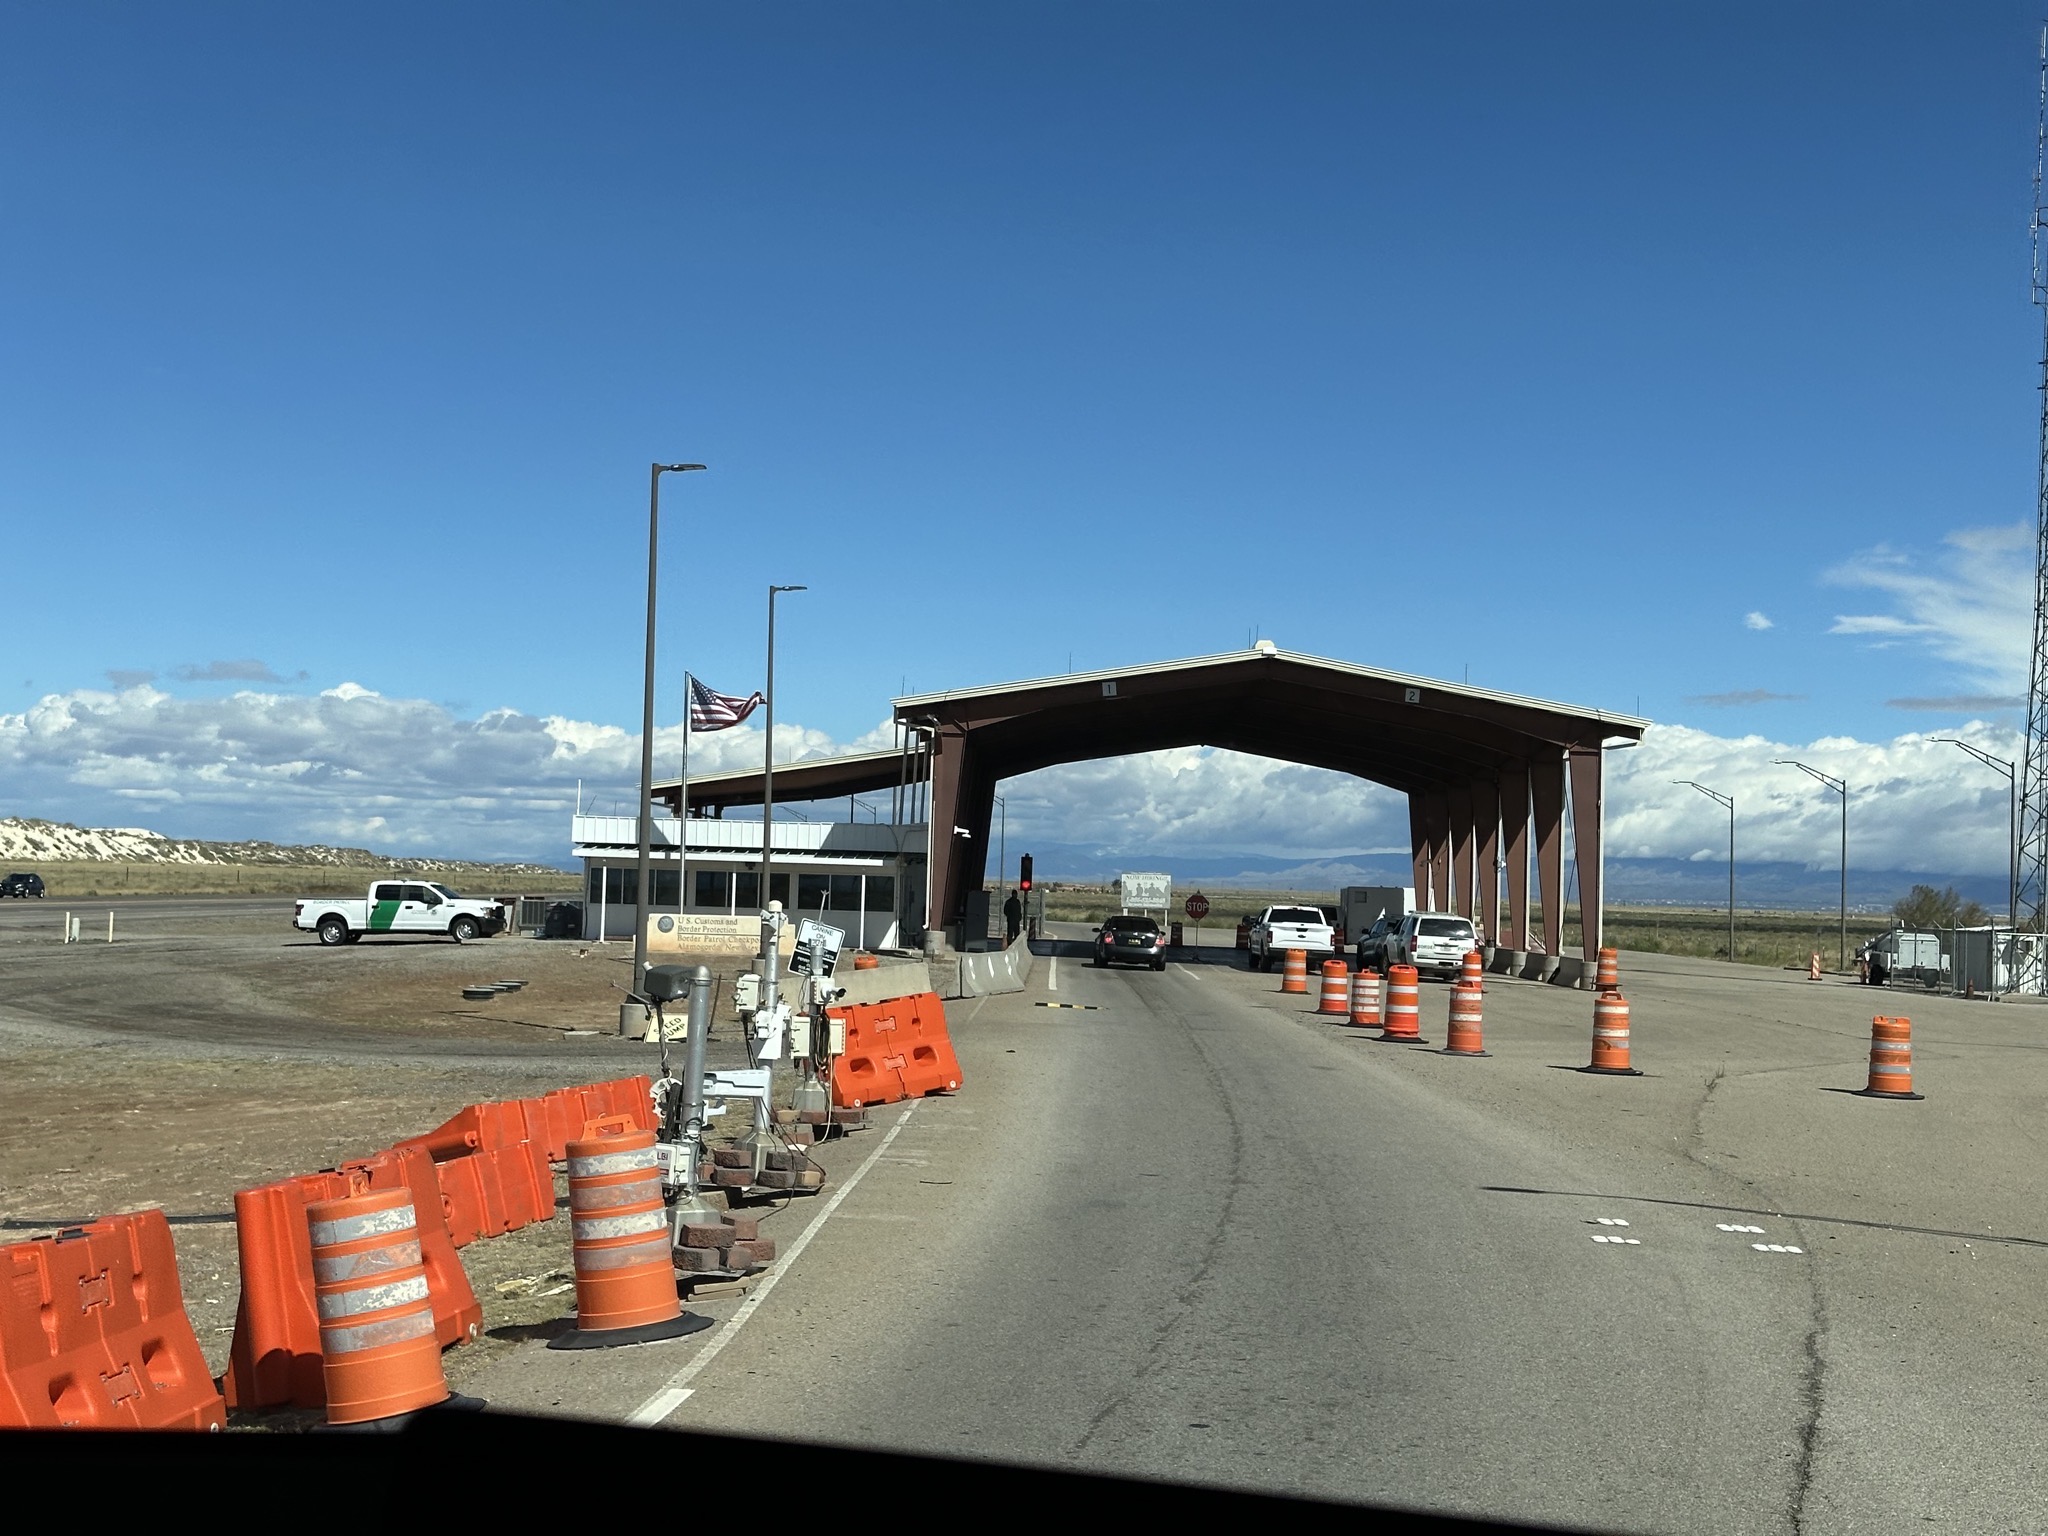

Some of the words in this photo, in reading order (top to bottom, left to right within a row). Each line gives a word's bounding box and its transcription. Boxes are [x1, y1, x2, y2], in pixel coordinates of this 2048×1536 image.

[1409, 690, 1416, 701] 2
[1186, 902, 1208, 911] STOP
[694, 917, 724, 925] Customs
[725, 918, 738, 926] and
[703, 935, 726, 943] Patrol
[728, 935, 761, 944] Checkpo
